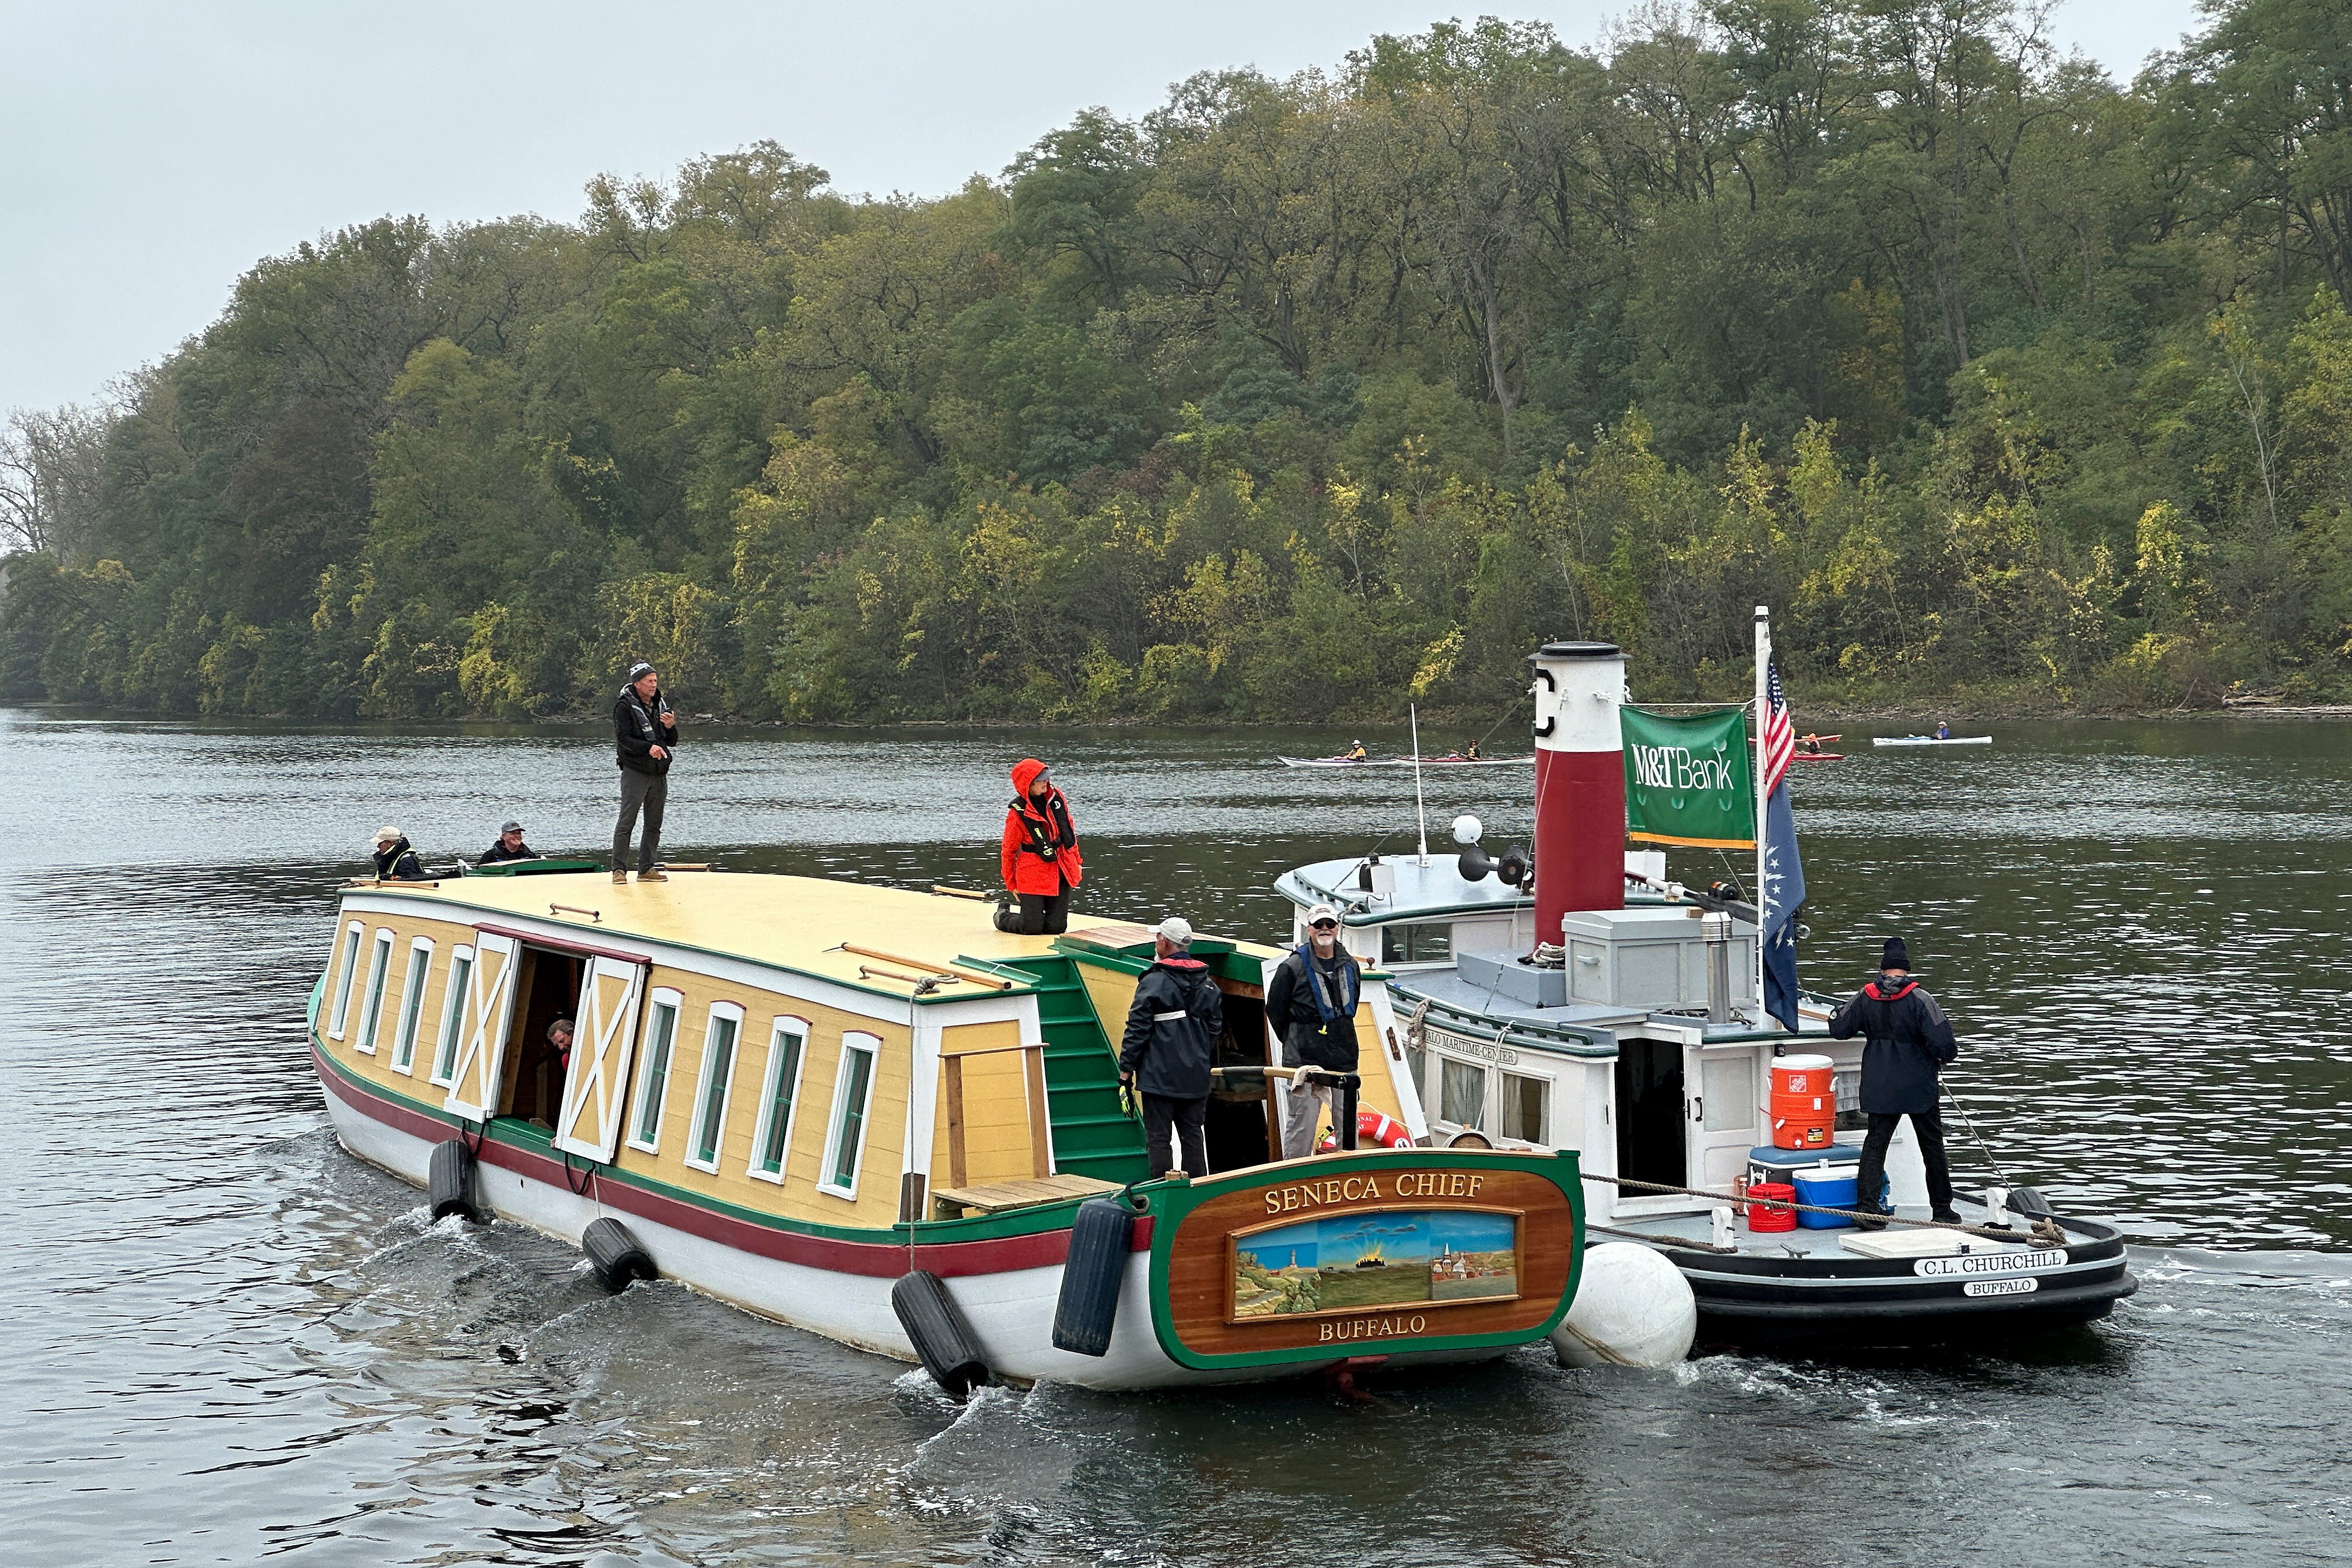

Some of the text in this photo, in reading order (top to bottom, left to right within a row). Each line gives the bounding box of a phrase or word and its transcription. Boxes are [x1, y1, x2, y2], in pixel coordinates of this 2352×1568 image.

[1631, 743, 1734, 790] M&T Bank
[1265, 1173, 1484, 1214] SENECA CHIEF
[1924, 1252, 2062, 1275] C.L. CHURCHILL
[1972, 1280, 2031, 1295] BUFFALO
[1318, 1315, 1426, 1341] BUFFALO
